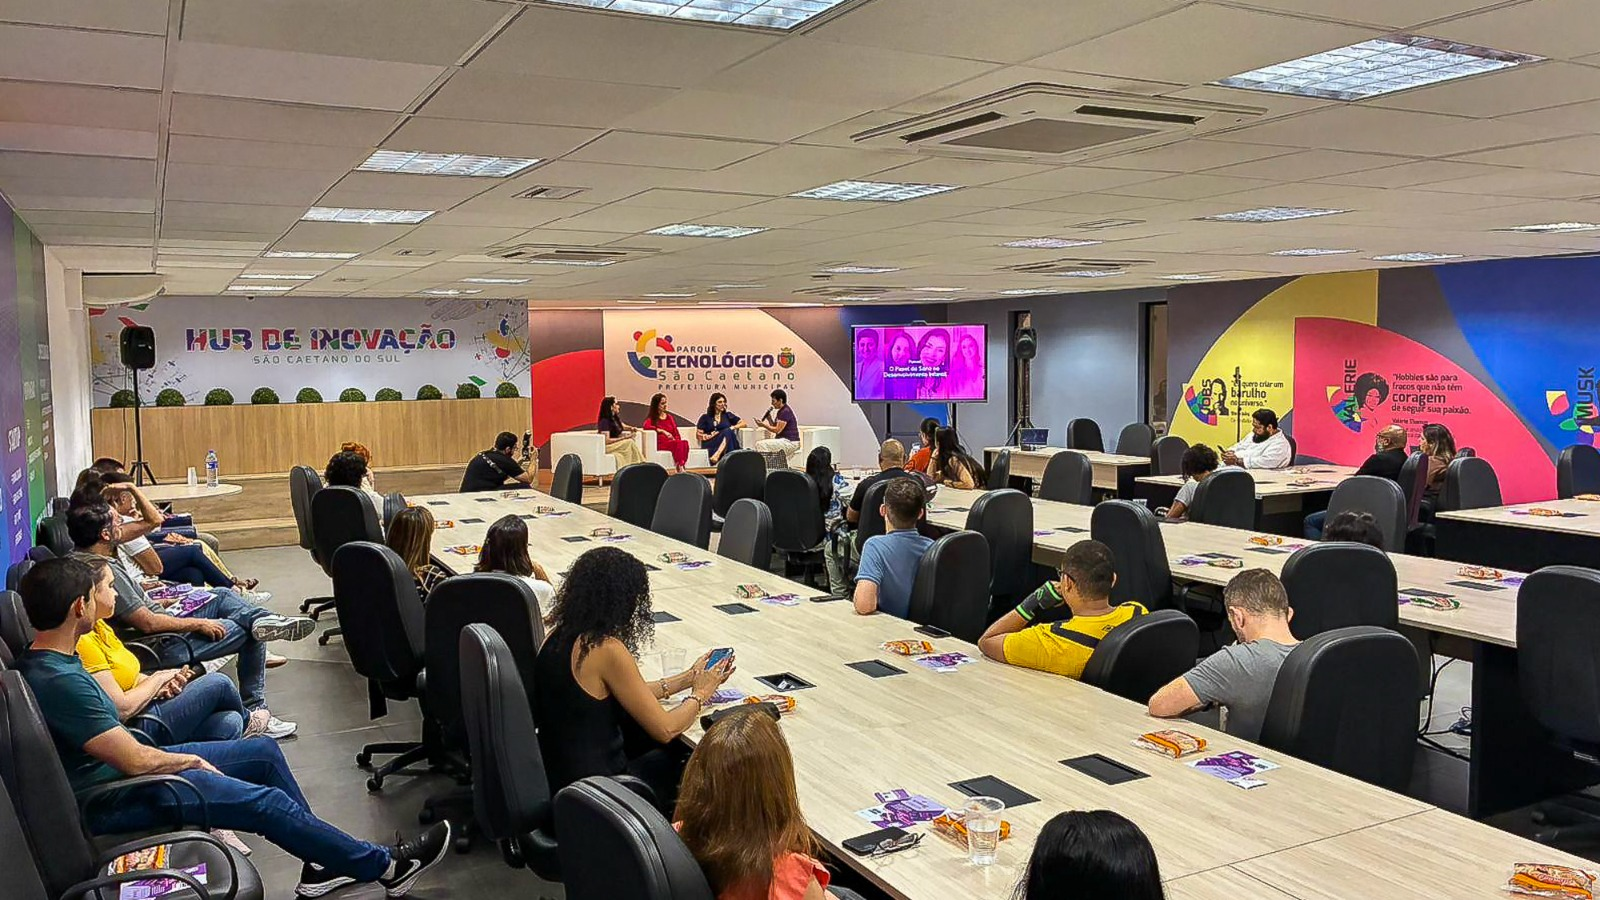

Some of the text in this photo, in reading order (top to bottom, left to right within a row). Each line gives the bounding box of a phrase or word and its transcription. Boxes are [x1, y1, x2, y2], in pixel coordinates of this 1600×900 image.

[185, 322, 456, 355] HUB DE INOVAÇÃO
[677, 345, 718, 353] PARQUE
[253, 353, 401, 365] SÃO CAETANO DO SUL
[654, 351, 774, 368] TECNOLÓGICO
[658, 370, 796, 381] São Caetano
[1440, 374, 1458, 384] para
[1241, 381, 1258, 389] quero
[1343, 359, 1357, 423] VALERIE
[1392, 381, 1415, 391] fracos
[1416, 384, 1430, 393] que
[1430, 382, 1446, 391] não
[1230, 387, 1267, 399] barulho
[1576, 366, 1595, 419] MUSK
[1392, 393, 1446, 406] coragem
[1391, 404, 1472, 416] de seguir sua paixão.
